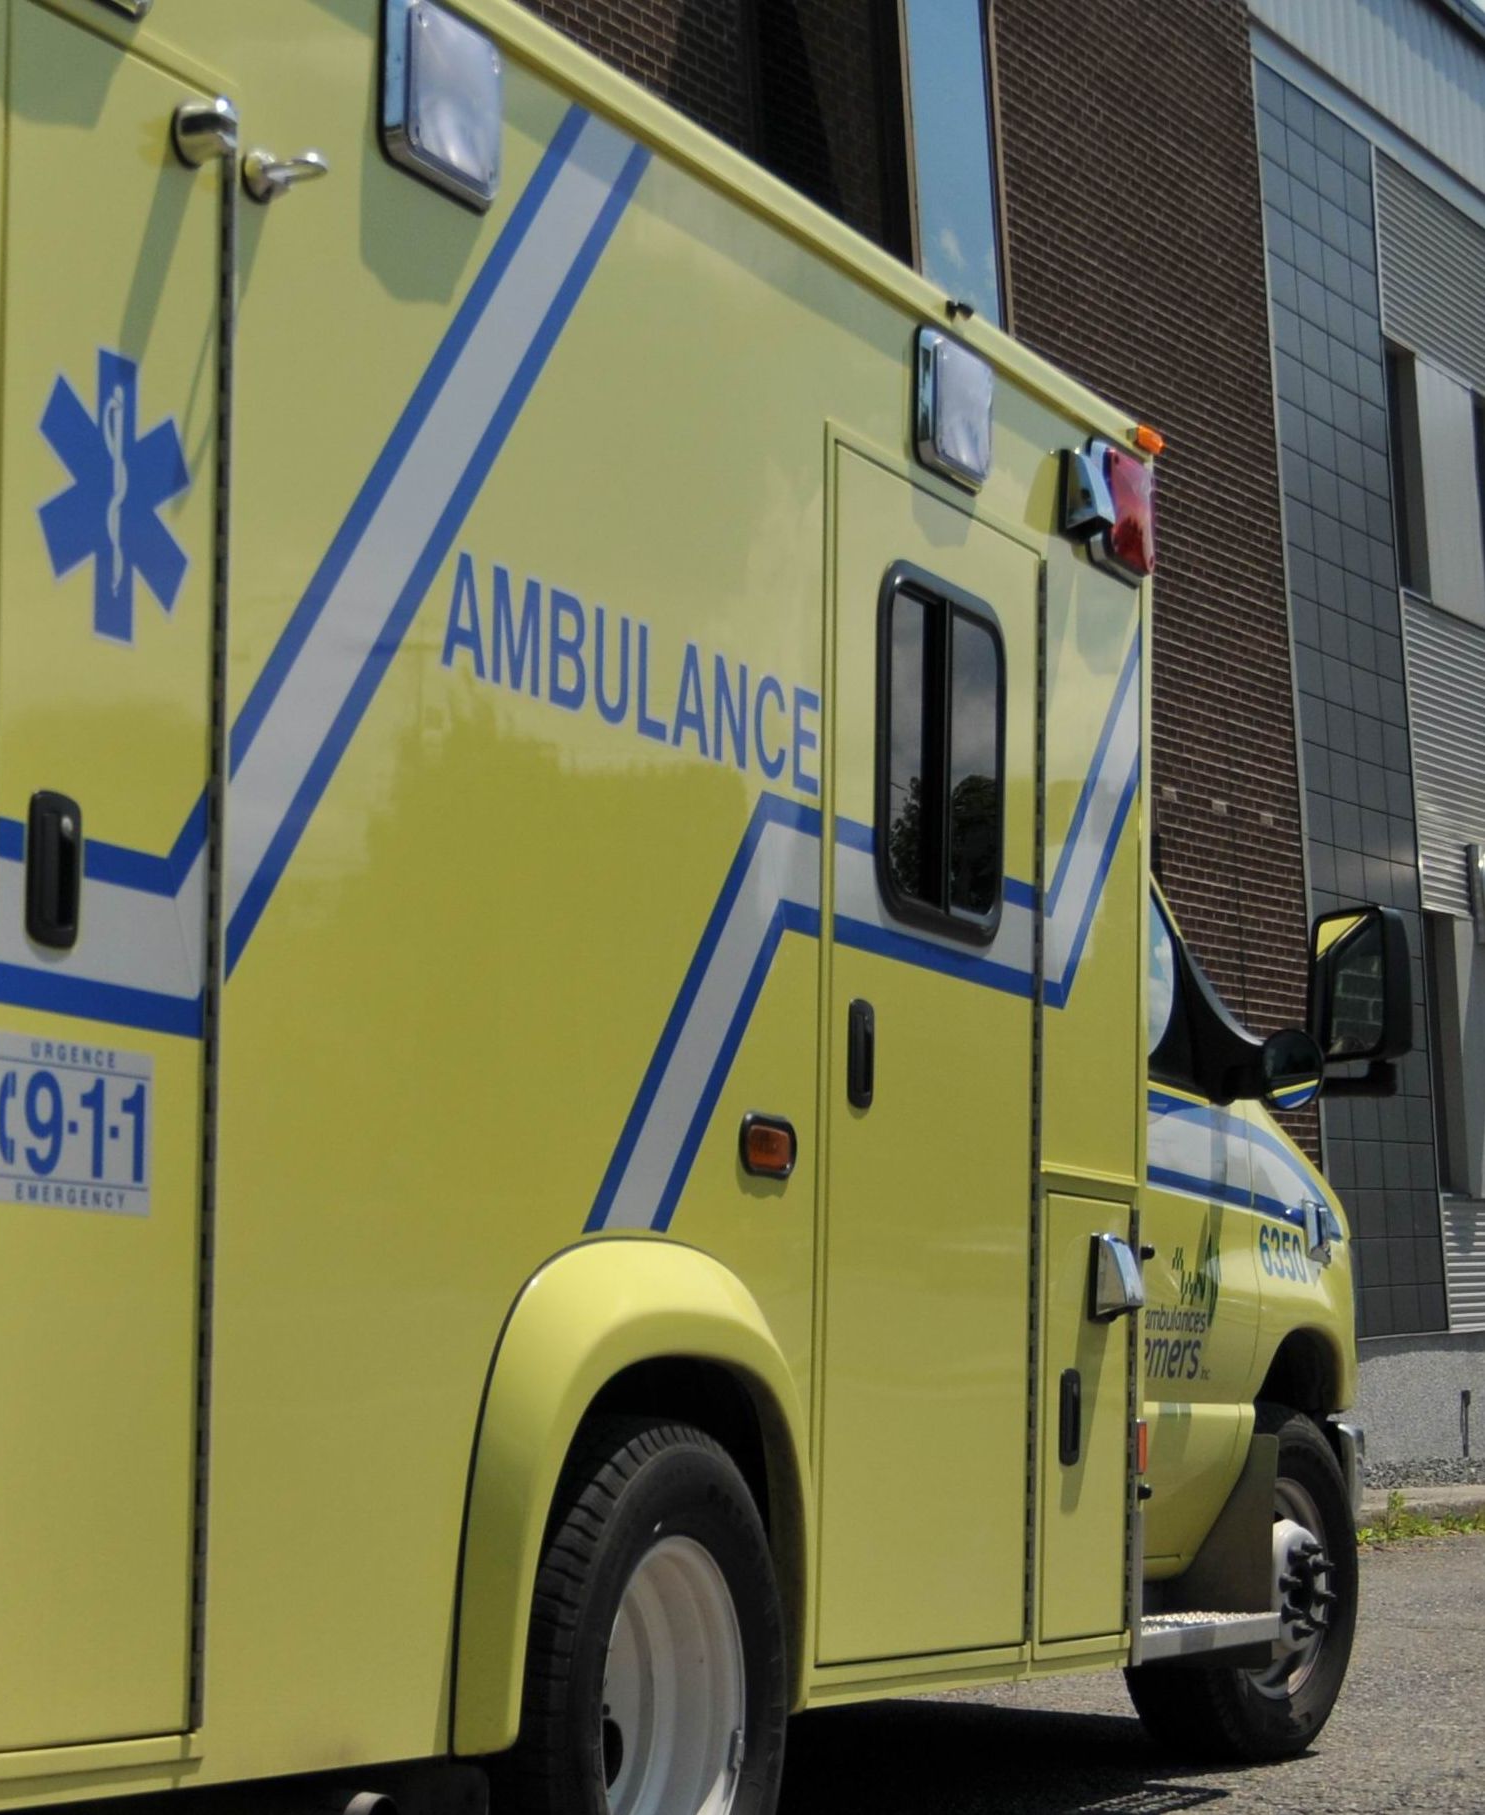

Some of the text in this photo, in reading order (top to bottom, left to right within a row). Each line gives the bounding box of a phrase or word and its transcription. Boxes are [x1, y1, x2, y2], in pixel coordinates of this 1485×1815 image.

[440, 552, 820, 795] AMBULANCE
[30, 1040, 117, 1070] URGENCE
[23, 1069, 145, 1184] 9-1-1
[15, 1183, 127, 1210] EMERGENCY
[1258, 1224, 1308, 1284] 6350
[1145, 1304, 1206, 1333] ambulances
